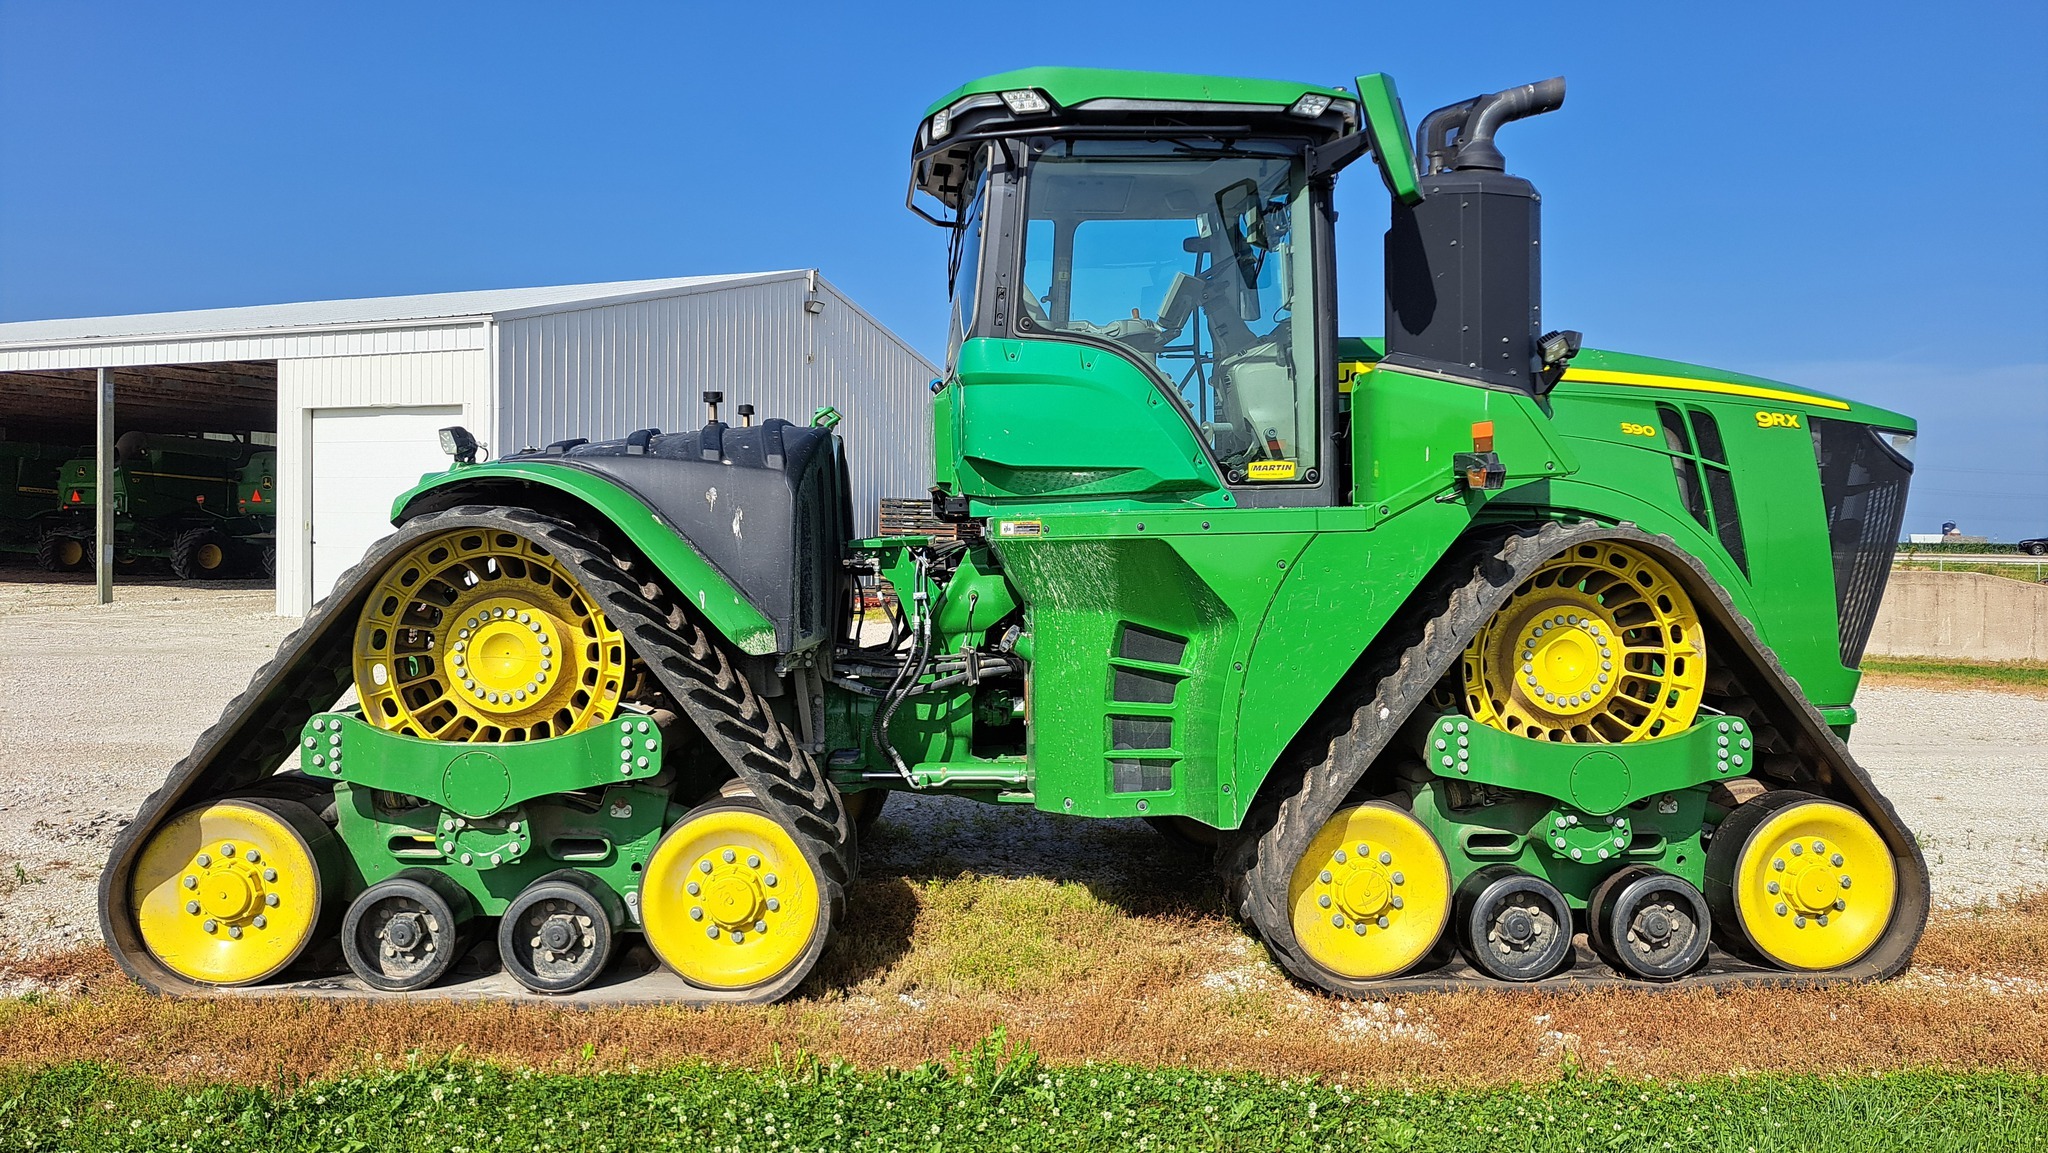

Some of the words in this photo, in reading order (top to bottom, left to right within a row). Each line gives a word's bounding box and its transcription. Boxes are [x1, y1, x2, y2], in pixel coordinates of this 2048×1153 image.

[1755, 411, 1801, 429] 9RX
[1620, 422, 1656, 437] 590
[1252, 464, 1293, 472] MARTIN
